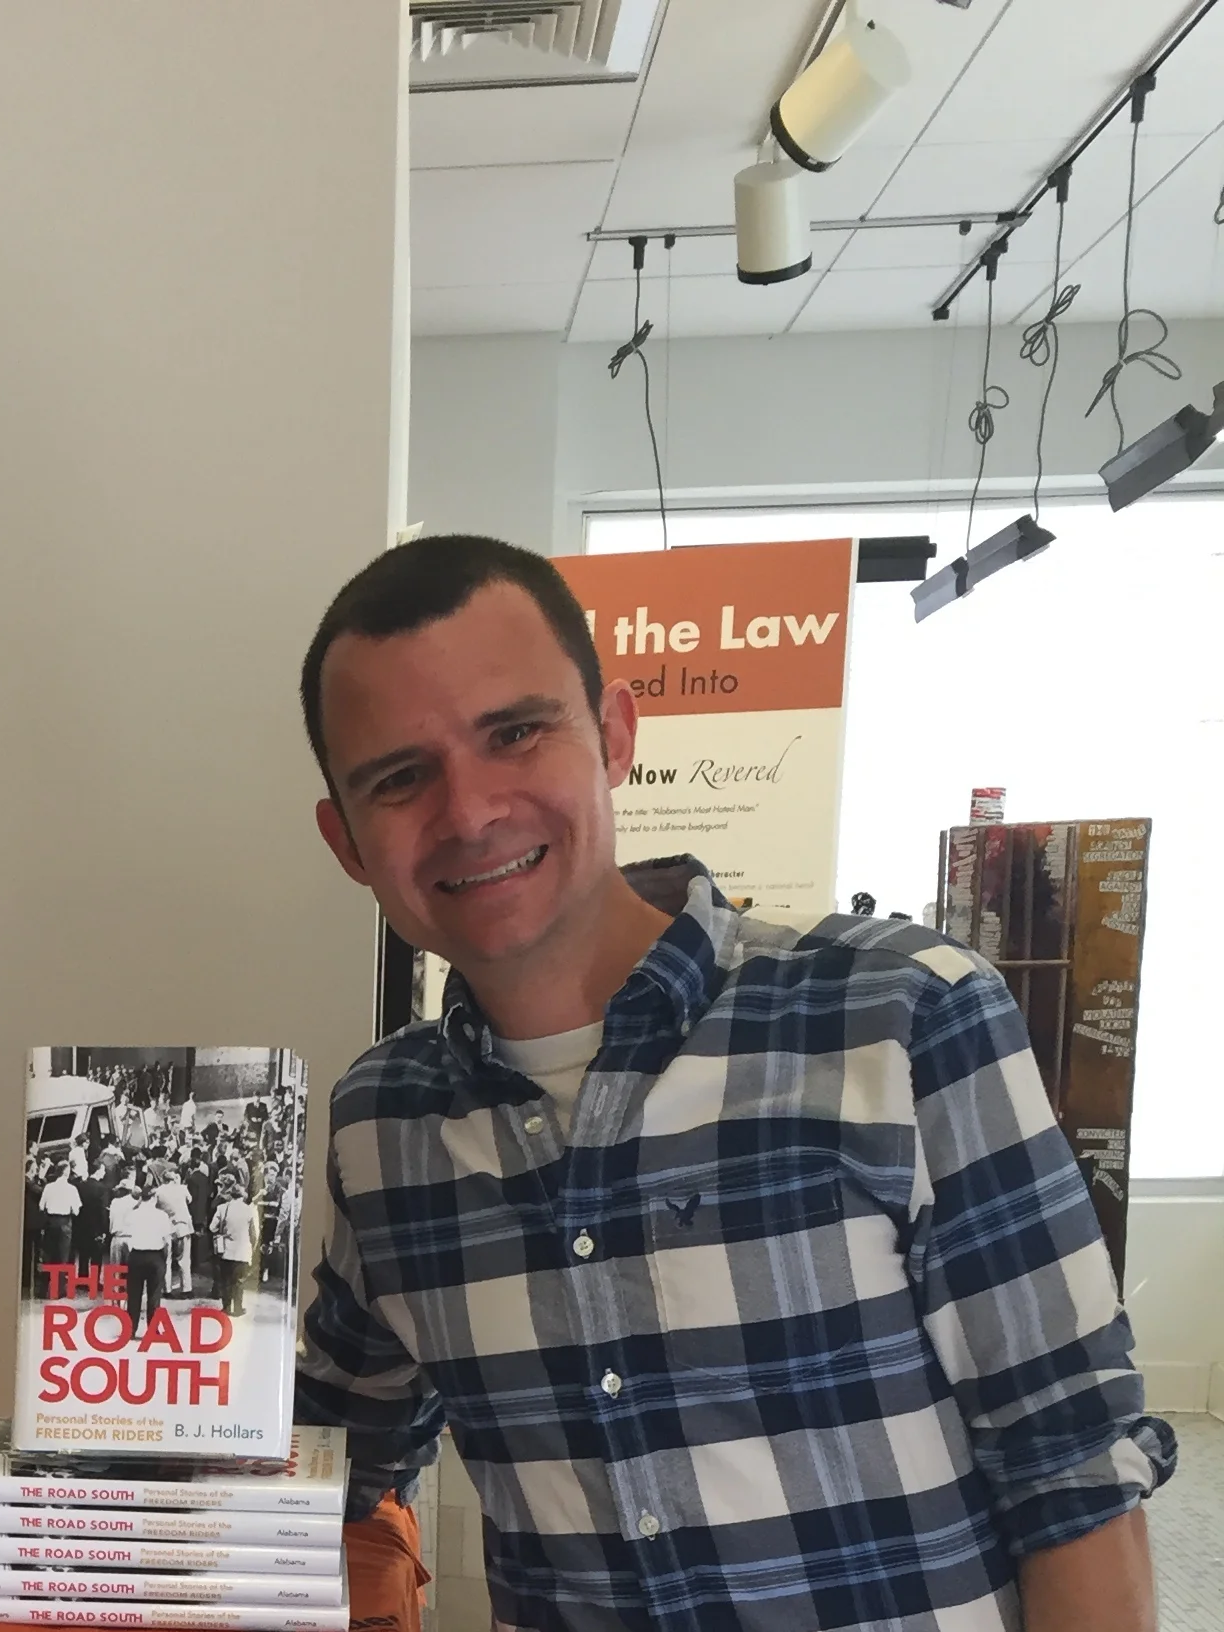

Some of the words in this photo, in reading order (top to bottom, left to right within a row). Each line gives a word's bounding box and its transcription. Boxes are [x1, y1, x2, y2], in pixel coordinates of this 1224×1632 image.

[614, 606, 701, 656] the
[719, 605, 840, 650] Law
[680, 667, 739, 695] Into
[629, 764, 678, 786] Now
[688, 735, 802, 790] Revered
[41, 1263, 129, 1300] THE
[42, 1305, 233, 1354] ROAD
[38, 1356, 230, 1406] SOUTH
[36, 1413, 87, 1426] Personal
[91, 1413, 133, 1426] Stories
[136, 1416, 146, 1426] of
[149, 1416, 164, 1426] the
[36, 1427, 107, 1440] FREEDOM
[112, 1429, 163, 1442] RIDERS
[175, 1424, 188, 1438] B.
[193, 1425, 205, 1438] J.
[211, 1424, 264, 1440] Hollars
[20, 1487, 42, 1498] THE
[48, 1488, 87, 1499] ROAD
[91, 1489, 135, 1501] SOUTH
[278, 1498, 310, 1506] Alabama
[20, 1517, 42, 1528] THE
[47, 1519, 86, 1530] ROAD
[90, 1520, 133, 1531] SOUTH
[277, 1529, 309, 1537] Alabama
[18, 1547, 40, 1558] THE
[45, 1548, 84, 1560] ROAD
[88, 1550, 131, 1561] SOUTH
[274, 1558, 306, 1566] Alabama
[21, 1581, 43, 1591] THE
[48, 1582, 87, 1593] ROAD
[92, 1583, 135, 1594] SOUTH
[30, 1610, 52, 1621] THE
[57, 1611, 96, 1622] ROAD
[100, 1612, 143, 1623] SOUTH
[285, 1619, 317, 1627] Alabama
